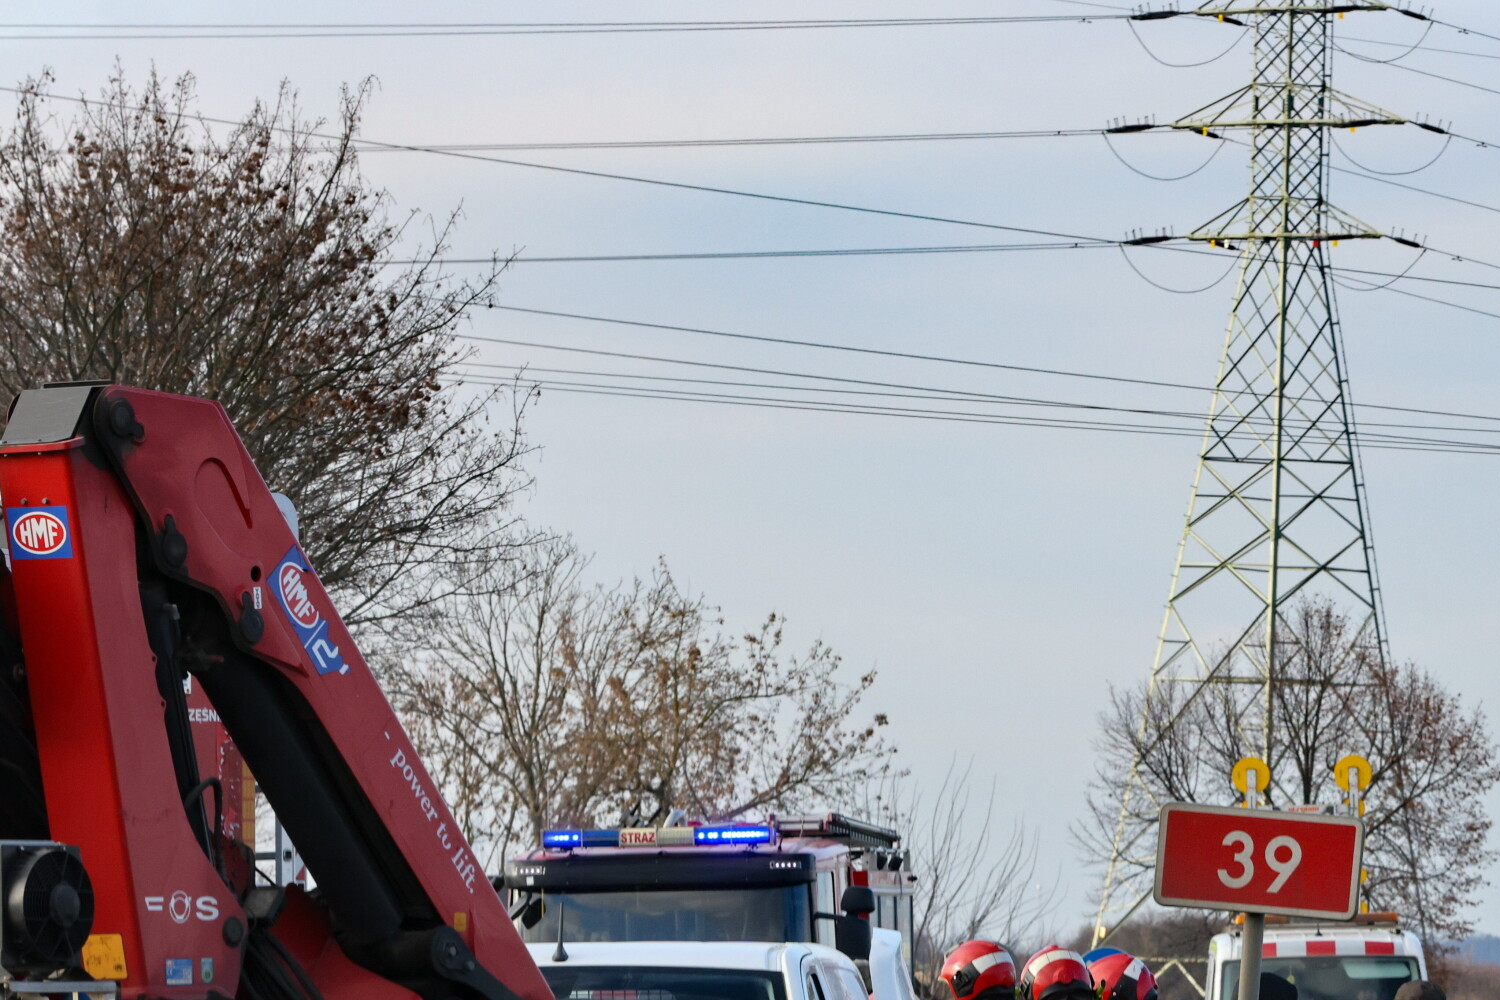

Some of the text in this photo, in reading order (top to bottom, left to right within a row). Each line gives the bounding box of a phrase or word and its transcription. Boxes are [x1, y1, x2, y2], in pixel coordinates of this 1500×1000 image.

[20, 517, 59, 549] HMF
[282, 568, 316, 619] HMF
[389, 748, 439, 822] power
[451, 847, 476, 895] lift.
[1217, 830, 1303, 894] 39
